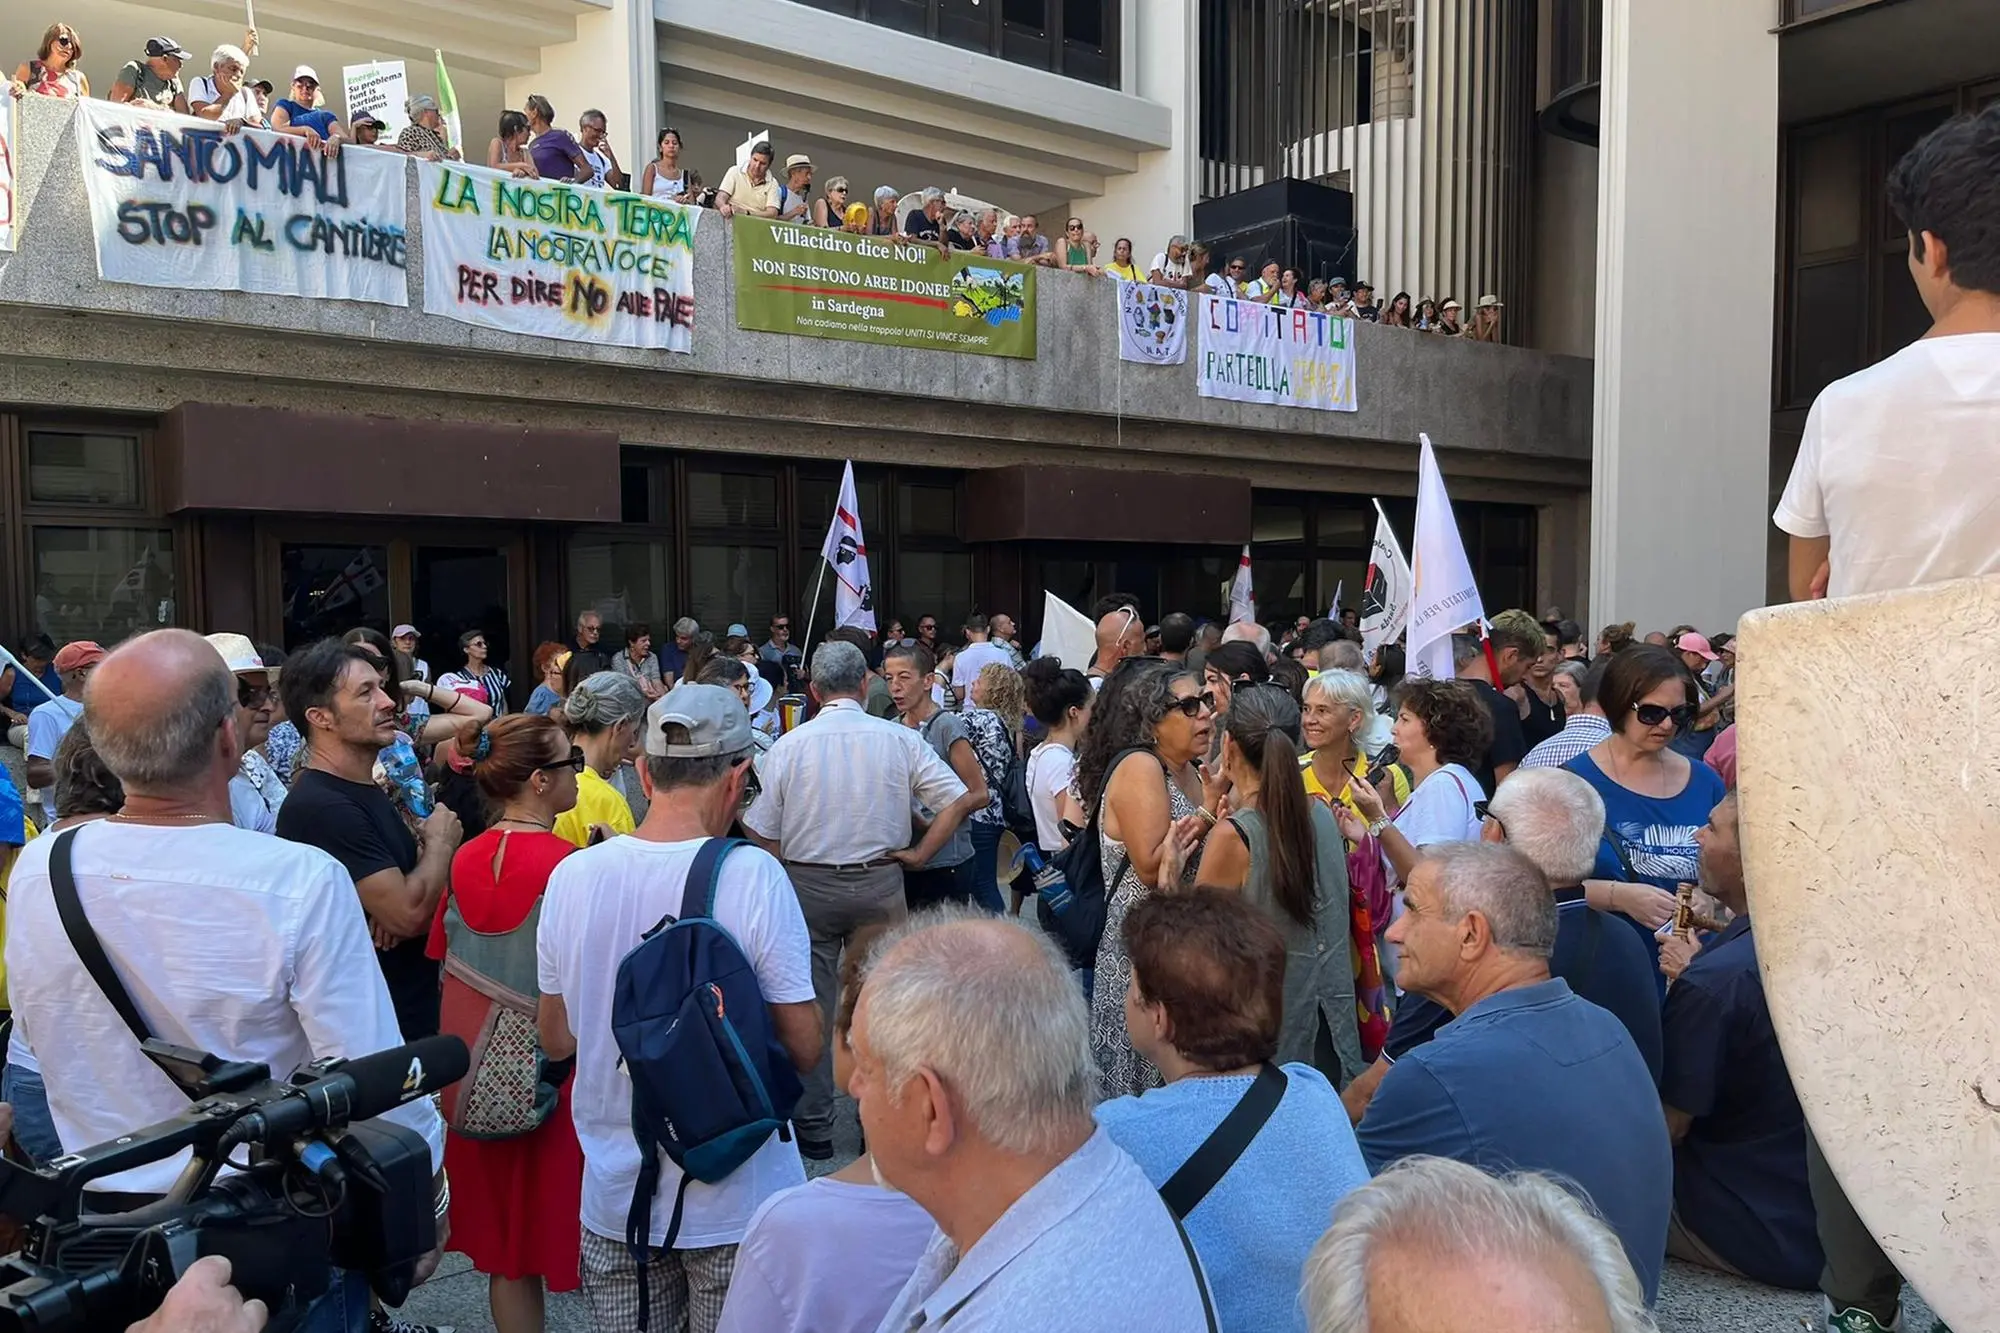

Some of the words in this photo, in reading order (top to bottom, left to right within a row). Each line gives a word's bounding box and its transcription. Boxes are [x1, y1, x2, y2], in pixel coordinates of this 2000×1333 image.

[350, 90, 366, 101] funt
[350, 94, 386, 109] partidus
[361, 73, 402, 90] problema
[117, 200, 217, 245] STOP
[231, 206, 275, 251] AL
[434, 168, 481, 216] LA
[492, 180, 606, 234] NOSTRA
[605, 193, 692, 252] TERRA
[488, 225, 513, 261] LA
[515, 229, 602, 274] NOSTRA
[602, 240, 670, 280] VOCE
[769, 225, 853, 254] Villacidro
[856, 238, 890, 260] dice
[894, 244, 927, 265] NO!!
[457, 264, 504, 306] PER
[571, 275, 609, 318] NO
[751, 257, 786, 276] NON
[788, 263, 861, 286] ESISTONO
[863, 274, 898, 291] AREE
[900, 278, 951, 298] IDONEE
[811, 296, 825, 311] in
[827, 297, 886, 320] Sardegna
[796, 315, 813, 325] Non
[814, 318, 848, 330] cadiamo
[848, 322, 869, 333] nella
[904, 327, 926, 338] UNITI
[926, 329, 935, 339] SI
[935, 330, 958, 343] VINCE
[958, 333, 990, 346] SEMPRE
[1207, 350, 1290, 397] PARTEOLLA
